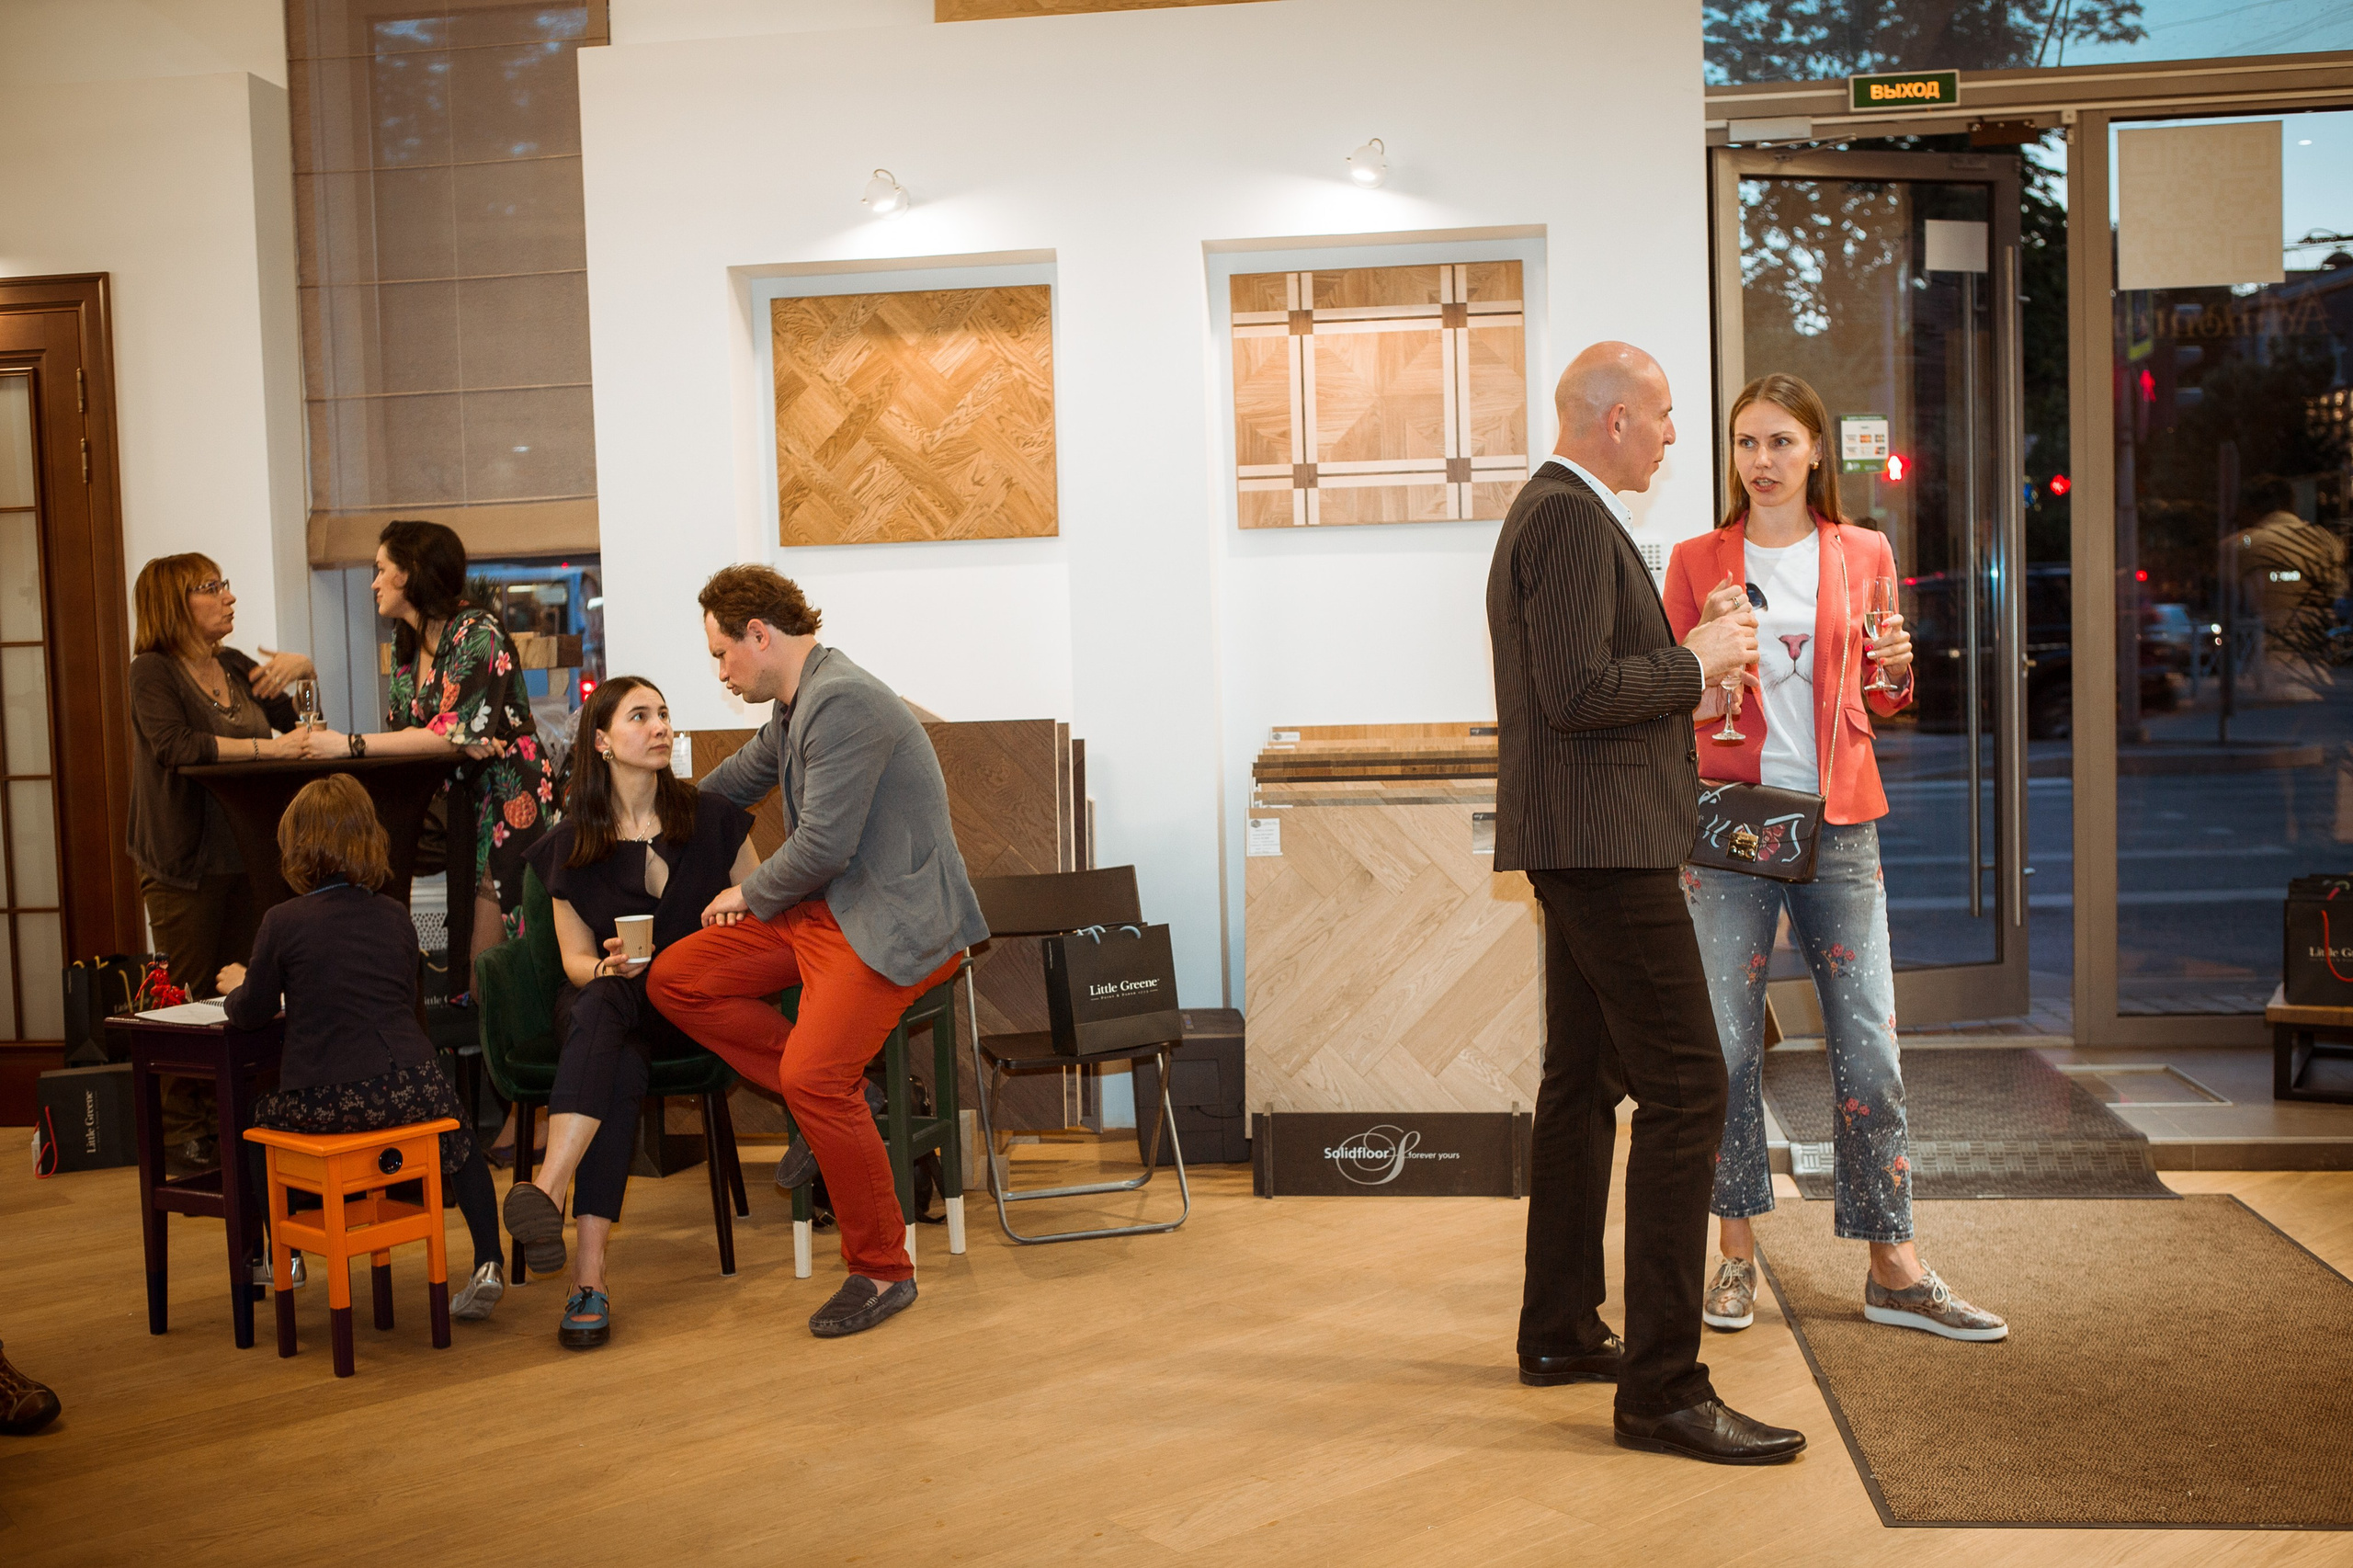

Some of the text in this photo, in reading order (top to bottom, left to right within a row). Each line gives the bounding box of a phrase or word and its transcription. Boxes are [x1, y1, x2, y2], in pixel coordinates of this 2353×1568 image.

[1870, 81, 1940, 100] ВЫХОД
[1089, 983, 1118, 996] Little
[1120, 978, 1158, 992] Greene
[84, 1090, 97, 1153] Little Greene
[1438, 1152, 1461, 1161] yours
